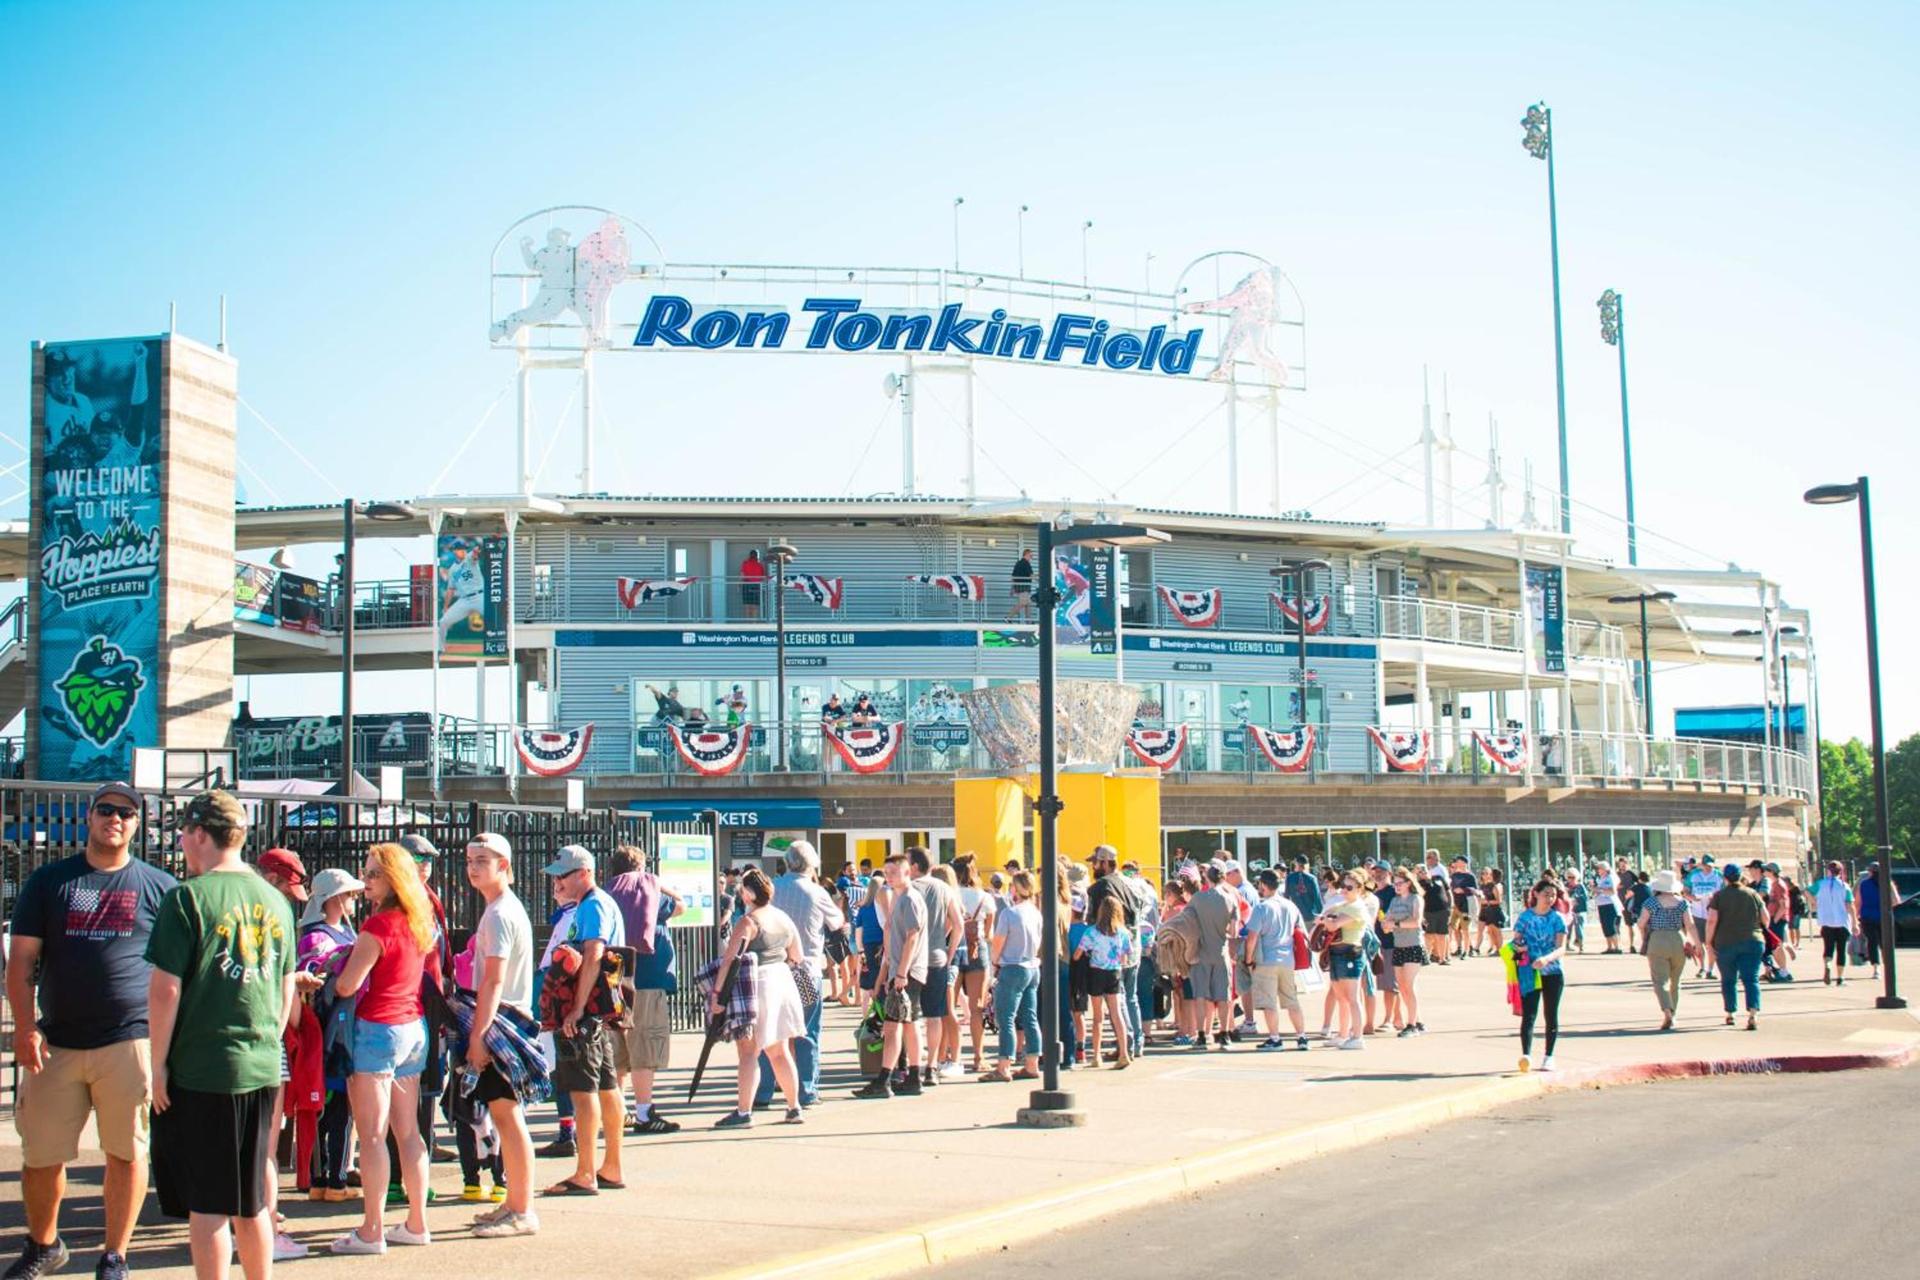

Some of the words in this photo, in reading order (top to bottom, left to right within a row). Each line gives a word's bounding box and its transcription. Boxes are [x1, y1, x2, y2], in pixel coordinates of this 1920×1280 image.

[633, 295, 791, 349] Ron
[801, 297, 1044, 360] Tonkin
[1043, 312, 1205, 375] Field
[55, 466, 152, 497] WELCOME
[75, 501, 95, 520] TO
[101, 499, 130, 518] THE
[41, 530, 160, 587] Hoppiest
[67, 585, 101, 602] PLACE
[111, 581, 145, 594] EARTH
[490, 561, 502, 603] KELLER
[1095, 563, 1107, 598] SMITH
[1547, 589, 1558, 620] SMITH
[698, 634, 740, 644] Washington
[741, 634, 759, 643] Trust
[760, 634, 778, 643] Bank
[784, 633, 827, 644] LEGENDS
[830, 633, 855, 644] CLUB
[1229, 642, 1264, 653] LEGENDS
[1265, 643, 1285, 654] CLUB
[693, 812, 758, 825] TKETS
[1732, 1059, 1782, 1073] PARKING
